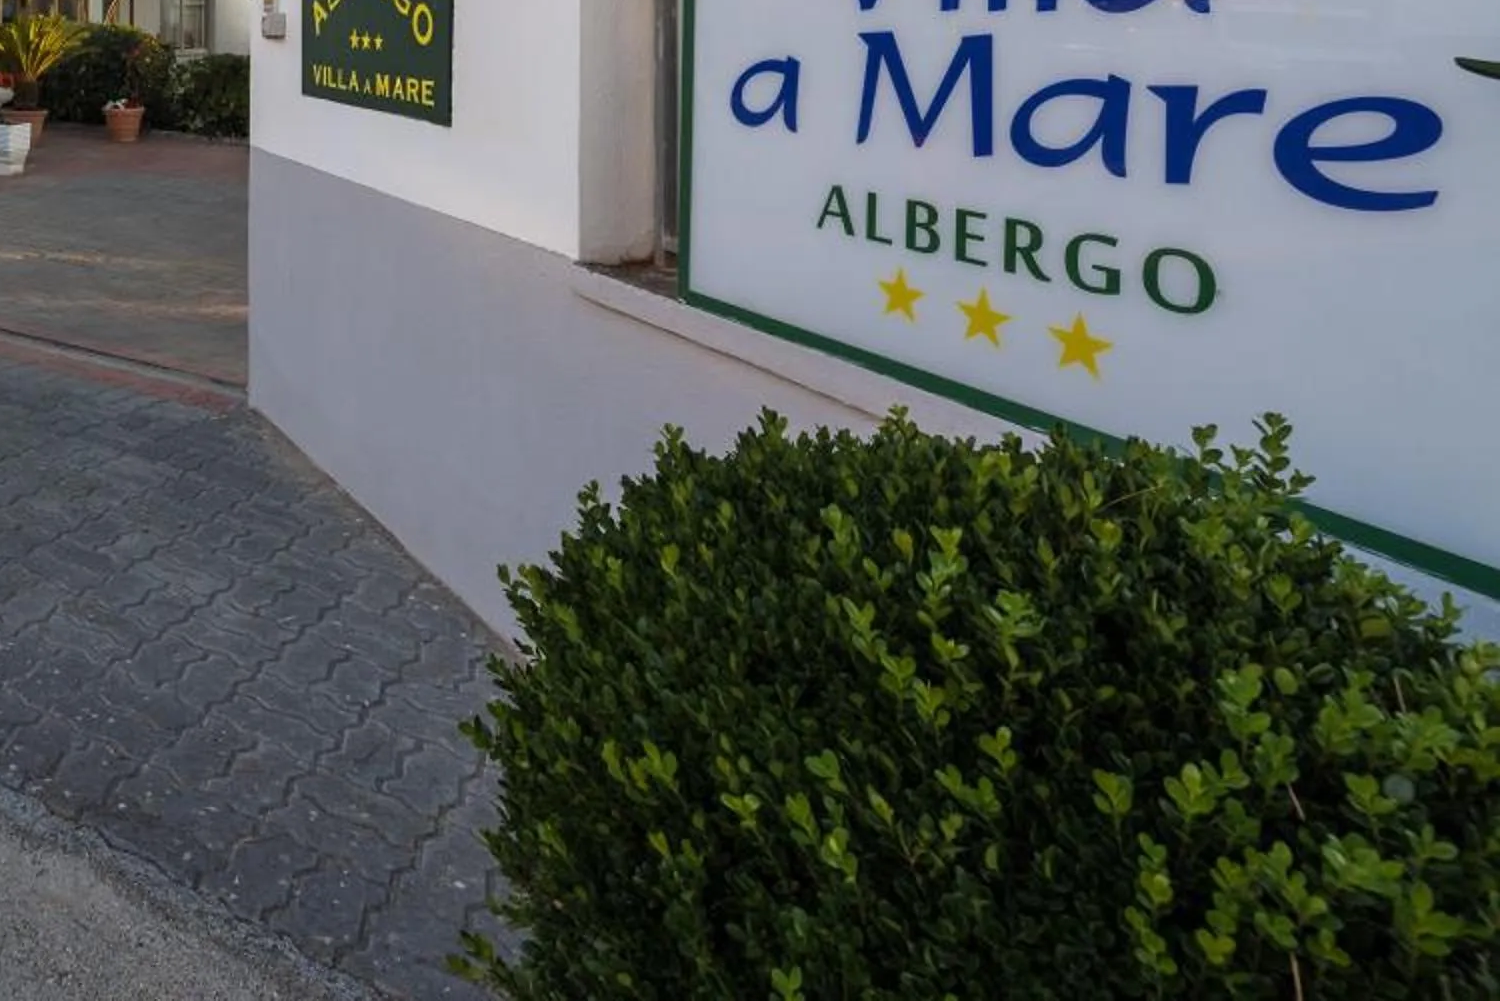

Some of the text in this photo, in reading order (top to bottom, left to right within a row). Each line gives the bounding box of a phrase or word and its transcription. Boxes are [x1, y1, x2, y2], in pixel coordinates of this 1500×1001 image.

[313, 64, 359, 92] VILLA
[375, 72, 435, 107] MARE
[729, 30, 1444, 213] a Mare
[815, 184, 1220, 316] ALBERGO
